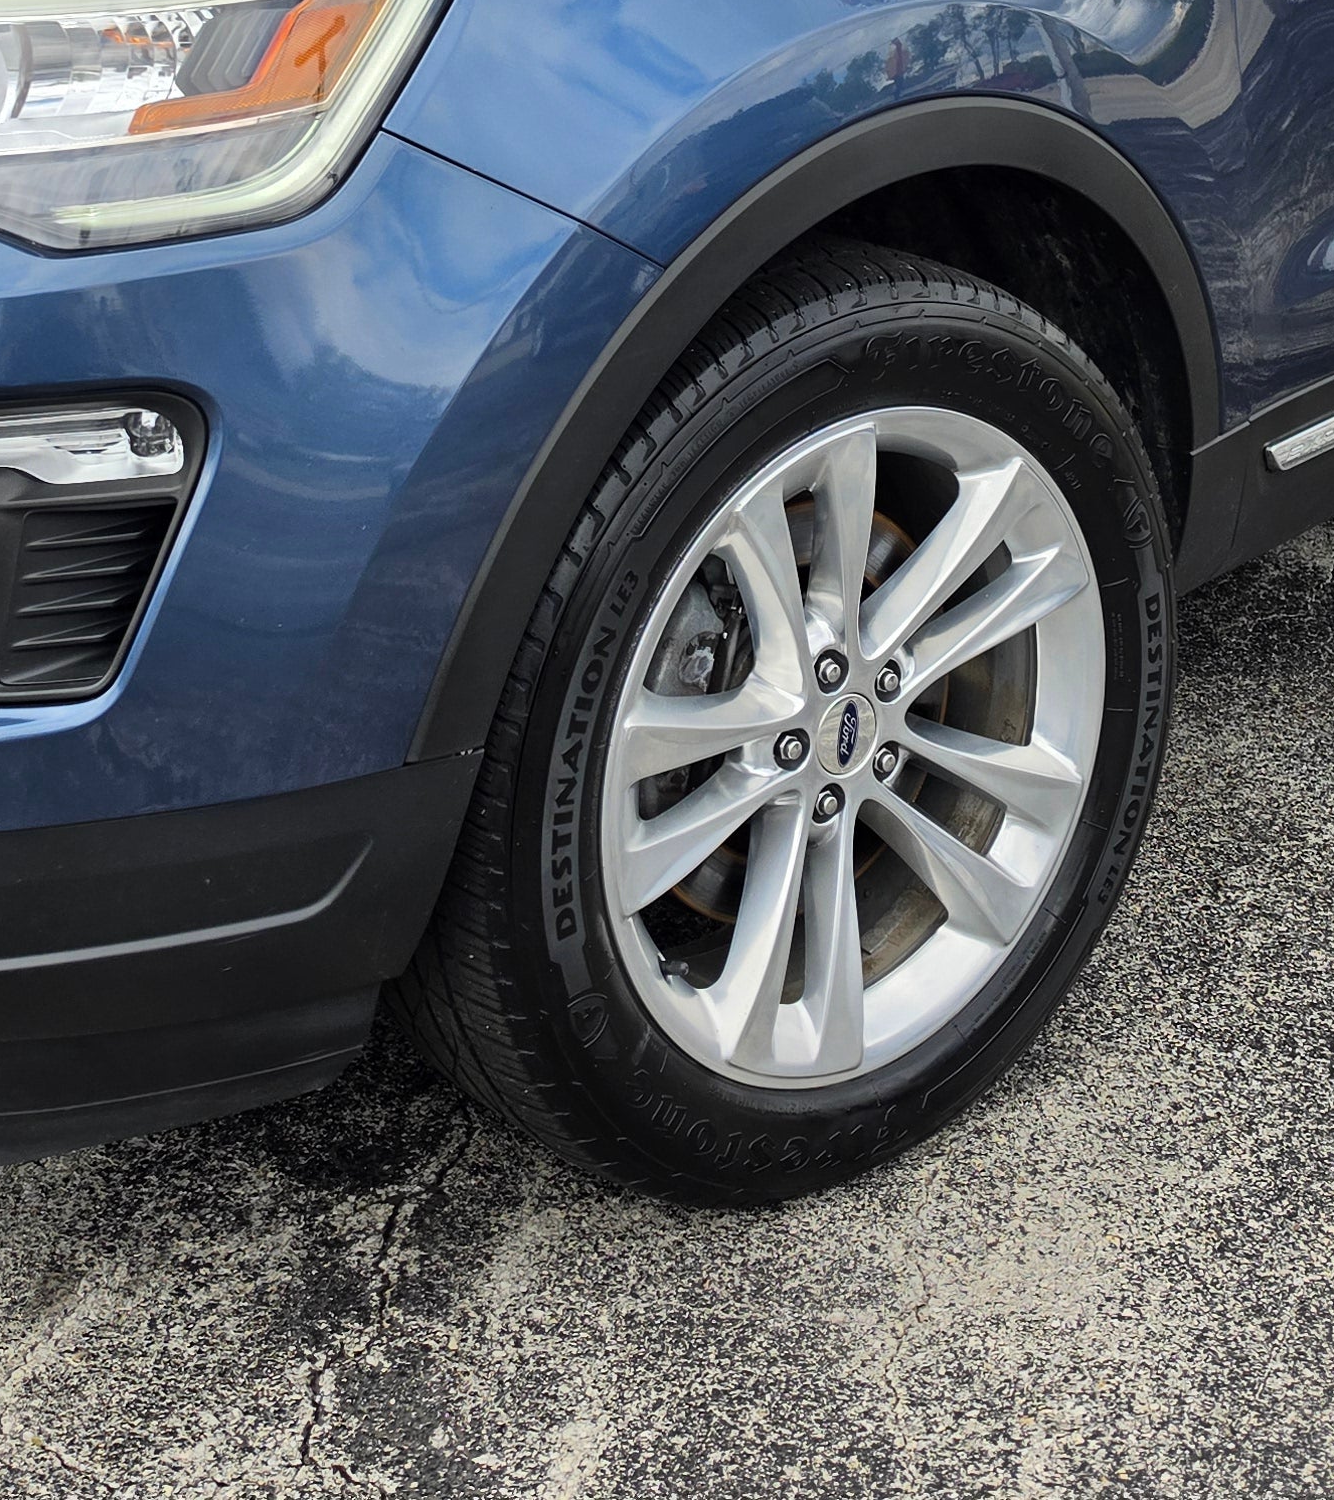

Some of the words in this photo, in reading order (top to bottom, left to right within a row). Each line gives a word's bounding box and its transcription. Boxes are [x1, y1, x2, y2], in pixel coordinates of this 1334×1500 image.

[864, 330, 1115, 469] Firestone
[551, 625, 617, 942] DESTINATION
[610, 569, 640, 620] LE3
[839, 712, 857, 756] Ford
[1113, 591, 1164, 856] DESTINATION
